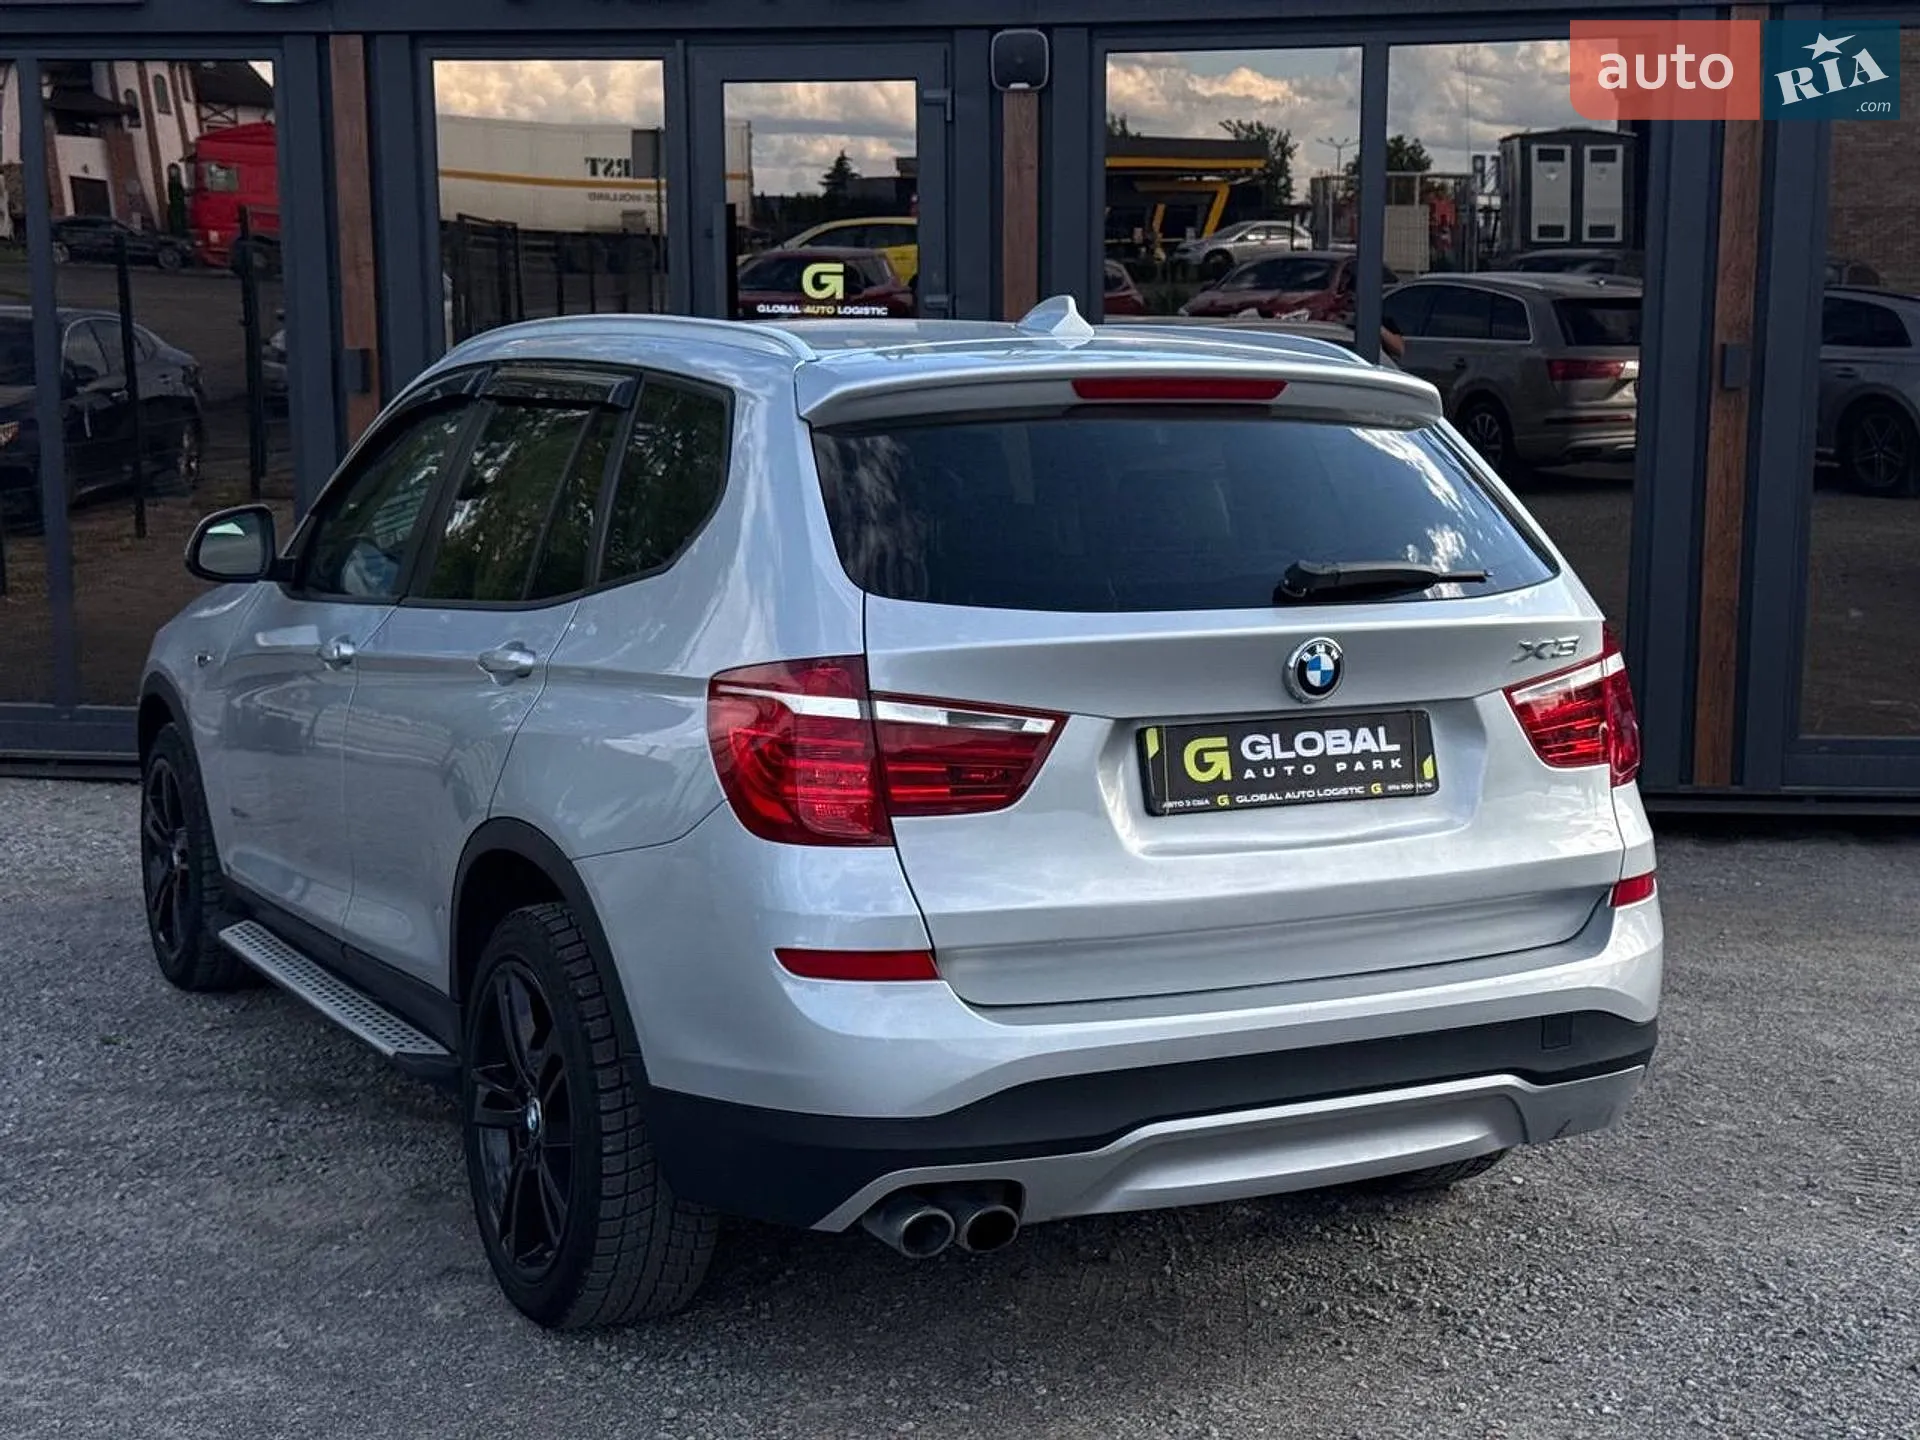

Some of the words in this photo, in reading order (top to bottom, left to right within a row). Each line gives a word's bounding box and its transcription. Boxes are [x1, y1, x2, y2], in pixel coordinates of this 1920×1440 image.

[757, 304, 801, 314] GLOBAL
[803, 305, 835, 315] AUTO
[837, 305, 888, 316] LOGISTIC
[1301, 644, 1340, 662] BMW
[1240, 726, 1400, 761] GLOBAL
[1243, 764, 1316, 780] AUTO
[1336, 757, 1402, 773] PARK
[1235, 792, 1283, 803] GLOBAL
[1284, 790, 1315, 800] AUTO
[1317, 786, 1366, 797] LOGISTIC
